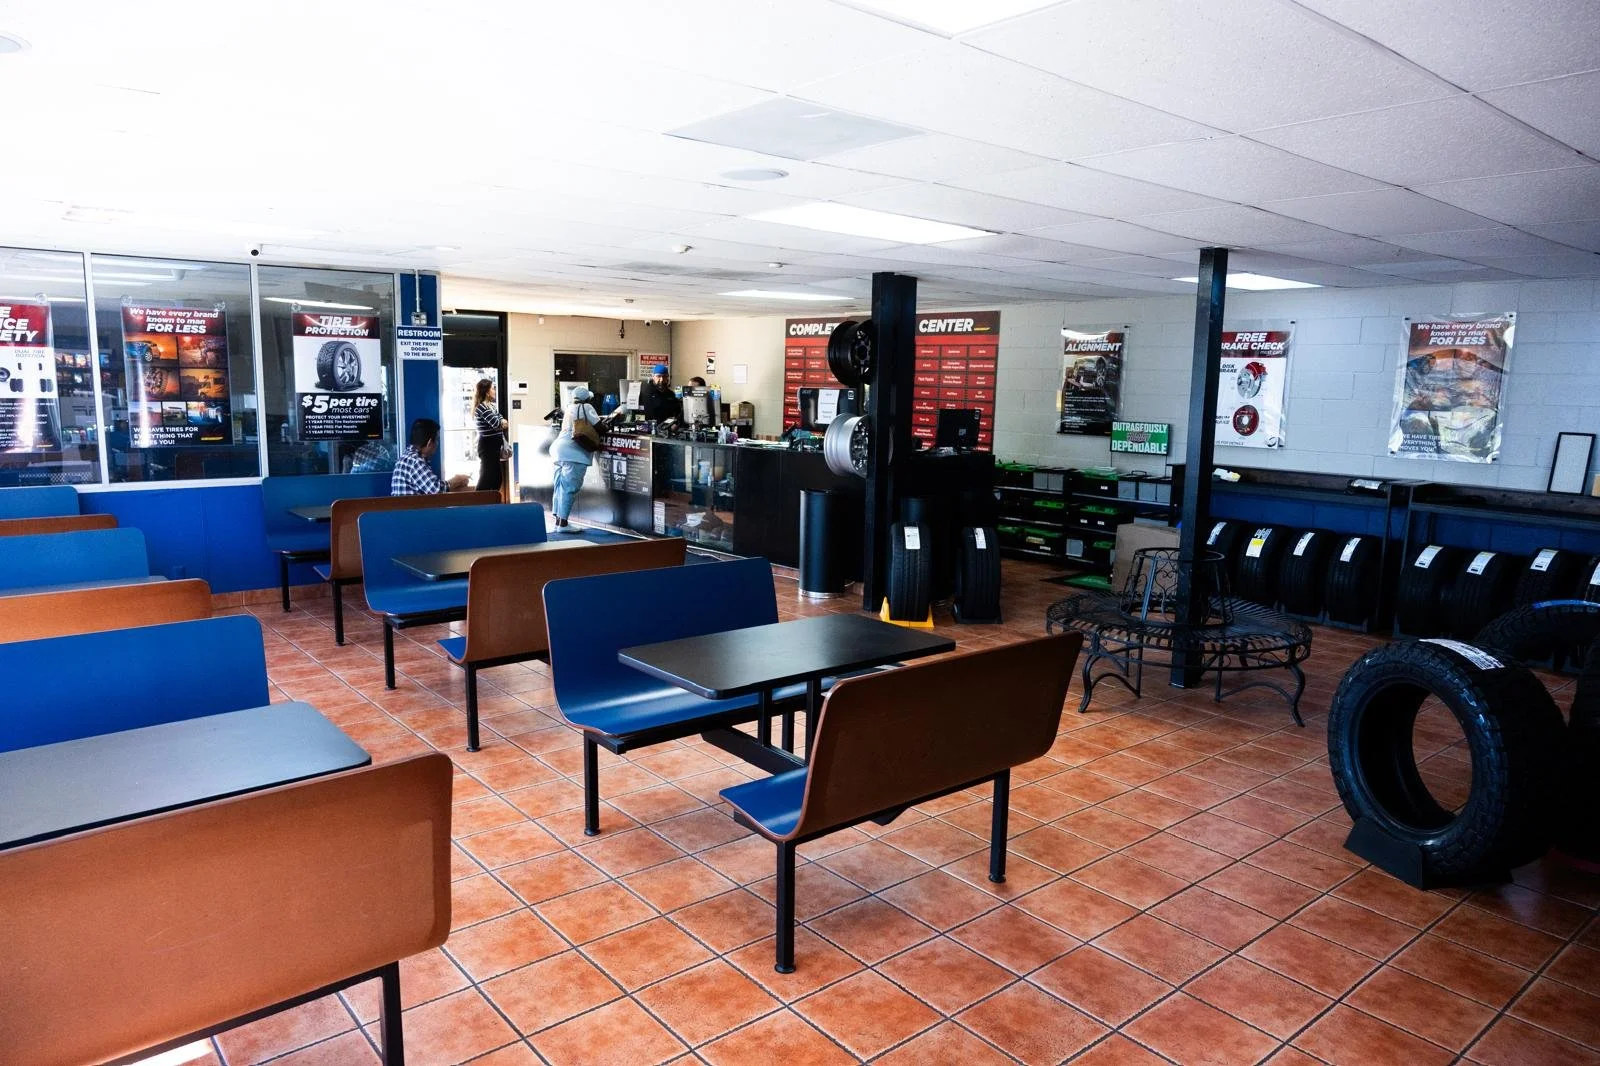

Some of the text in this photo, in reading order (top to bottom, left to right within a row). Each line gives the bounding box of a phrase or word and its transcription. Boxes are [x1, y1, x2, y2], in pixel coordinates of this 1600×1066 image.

[129, 307, 144, 315] We
[145, 308, 167, 317] have
[193, 310, 219, 318] brand
[146, 315, 174, 323] known
[176, 316, 186, 324] to
[319, 315, 353, 328] TIRE
[146, 323, 207, 334] FOR LESS
[918, 318, 974, 333] CENTER
[1431, 322, 1450, 330] have
[1451, 322, 1475, 330] every
[304, 326, 369, 337] PROTECTION
[397, 329, 441, 338] RESTROOM
[1235, 332, 1268, 342] FREE
[1250, 342, 1285, 350] CHECK
[1429, 336, 1486, 345] FOR LESS
[1065, 343, 1122, 351] ALIGNMENT
[301, 394, 379, 414] $5 per tire
[331, 406, 352, 414] most
[1112, 421, 1168, 433] OUTRAGEOUSLY
[611, 438, 641, 449] SERVICE
[1111, 440, 1167, 455] DEPENDABLE
